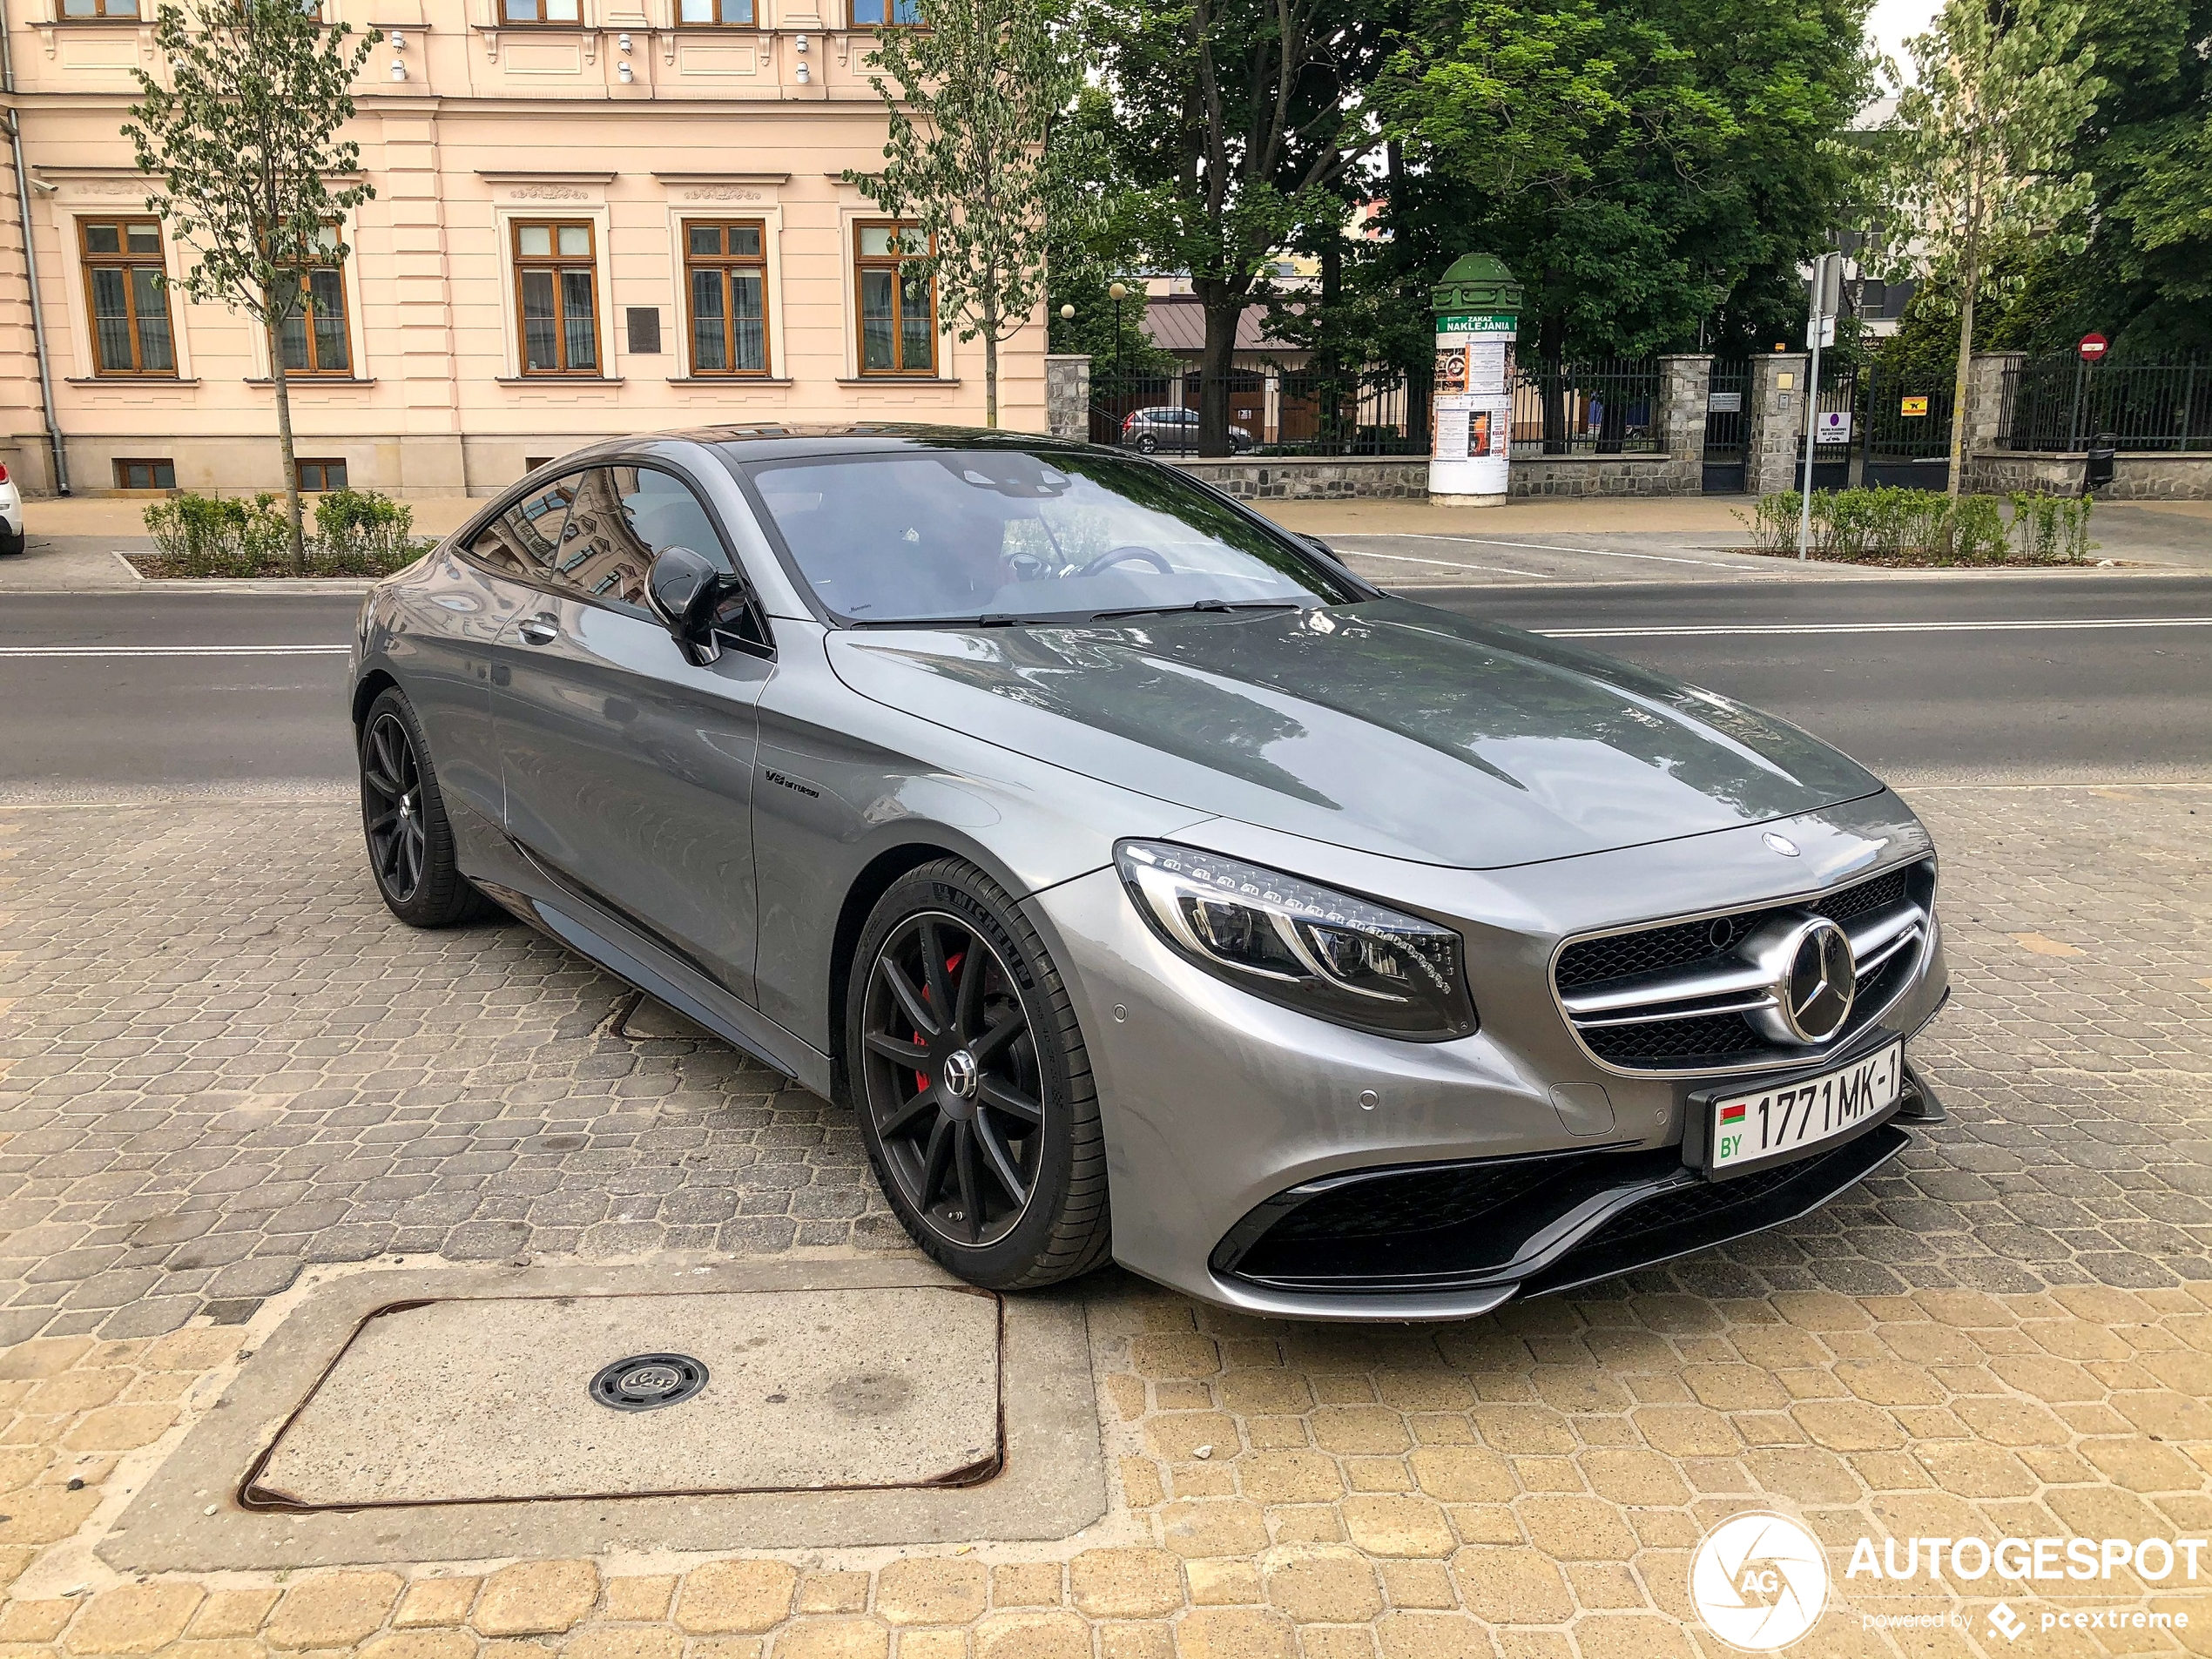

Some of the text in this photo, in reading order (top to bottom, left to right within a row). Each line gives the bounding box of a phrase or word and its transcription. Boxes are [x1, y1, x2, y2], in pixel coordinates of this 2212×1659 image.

[1447, 321, 1510, 332] NAKLEJANIA
[954, 891, 1030, 982] MICHELIN
[1757, 1049, 1897, 1150] 1771MK-1
[1720, 1133, 1743, 1159] BY
